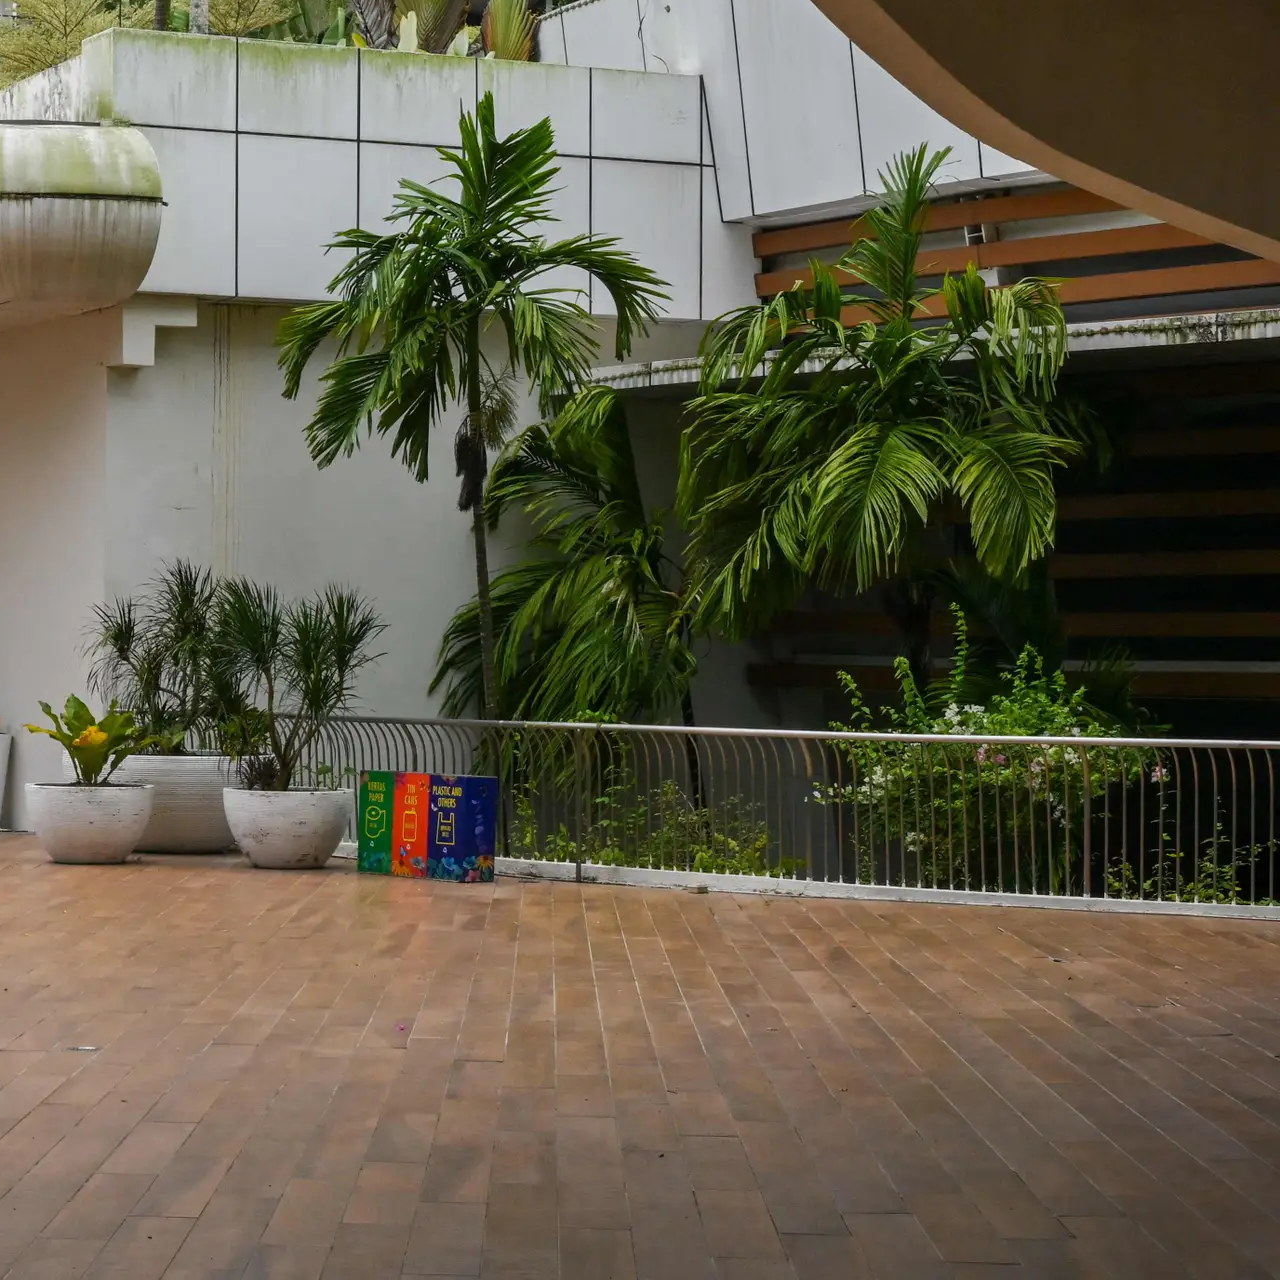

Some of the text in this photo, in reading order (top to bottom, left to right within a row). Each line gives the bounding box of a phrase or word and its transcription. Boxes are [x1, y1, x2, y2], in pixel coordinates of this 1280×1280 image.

[407, 784, 416, 794] TIN
[432, 785, 463, 797] PLASTIC AND
[368, 792, 385, 803] PAPER
[404, 795, 418, 805] CANS
[437, 798, 457, 808] OTHERS
